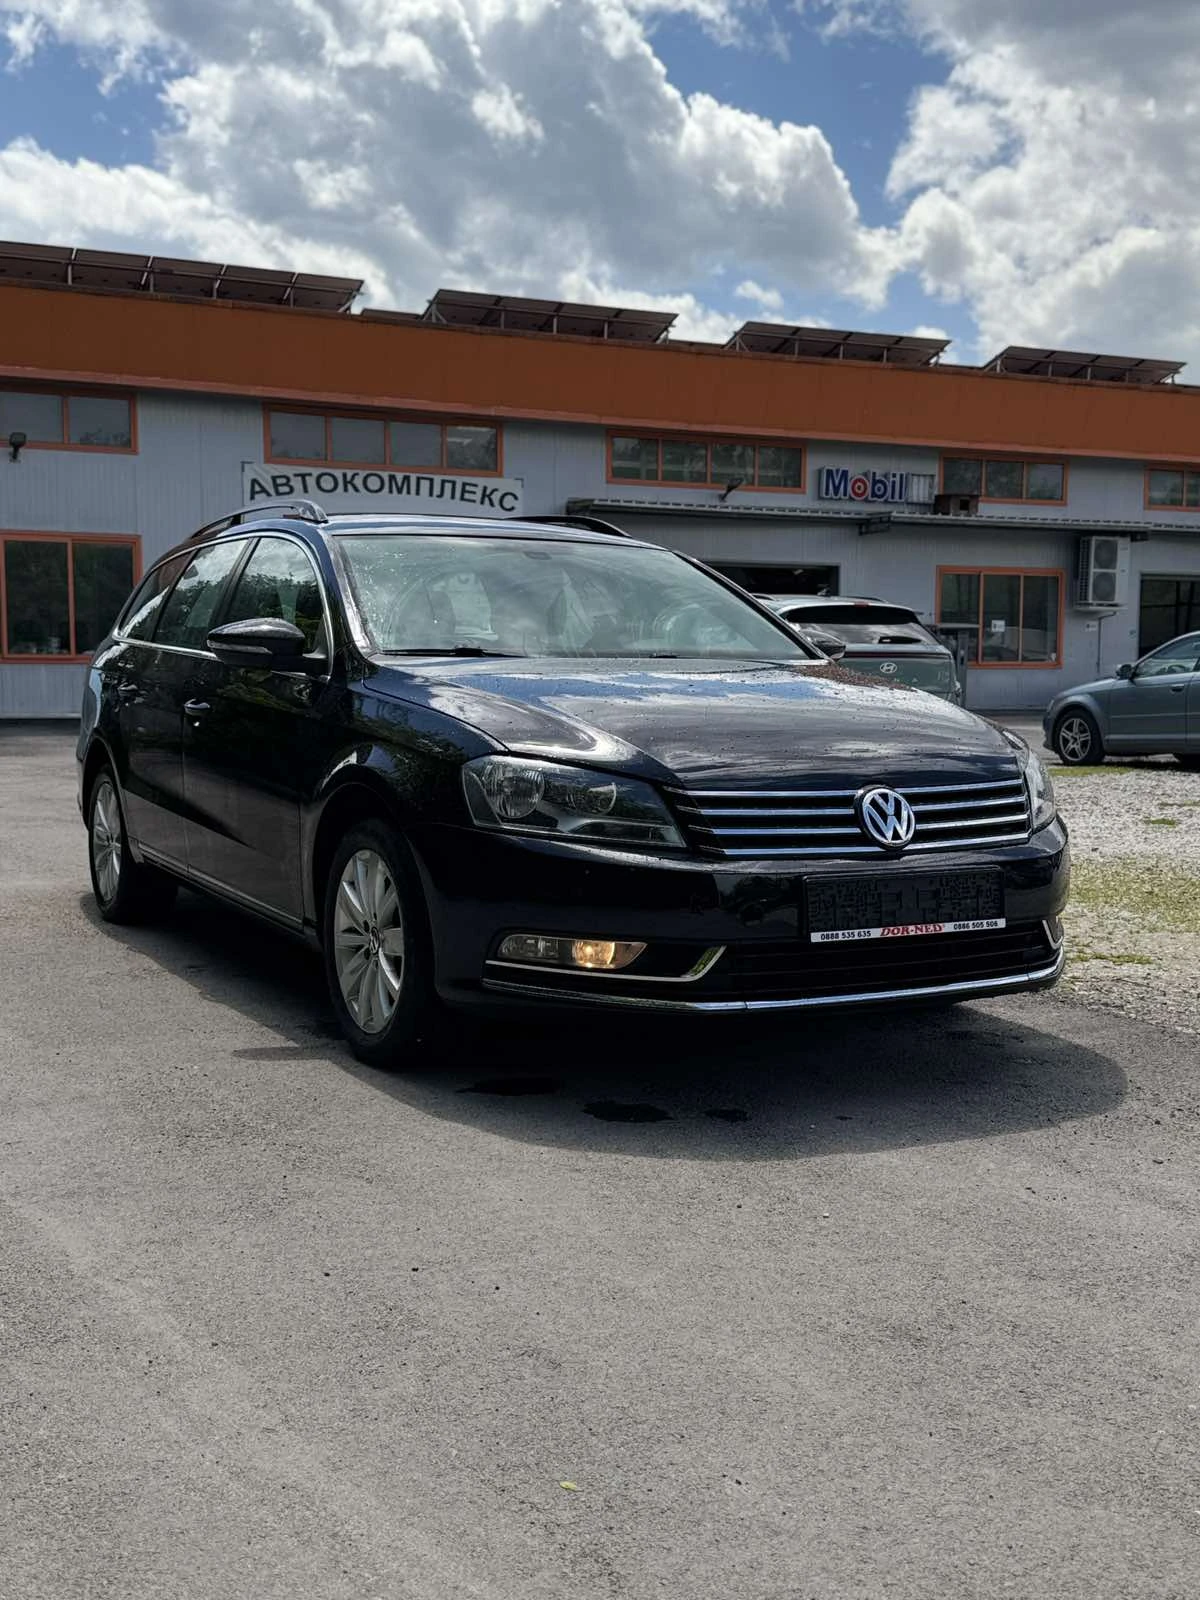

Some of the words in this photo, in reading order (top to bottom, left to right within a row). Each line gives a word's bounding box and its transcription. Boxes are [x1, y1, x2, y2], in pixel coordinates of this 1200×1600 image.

[249, 471, 520, 513] АВТОКОМПЛЕКС
[822, 467, 906, 501] Mobil
[820, 932, 840, 941] 0888
[841, 931, 856, 939] 535
[880, 924, 943, 937] DOR-NED
